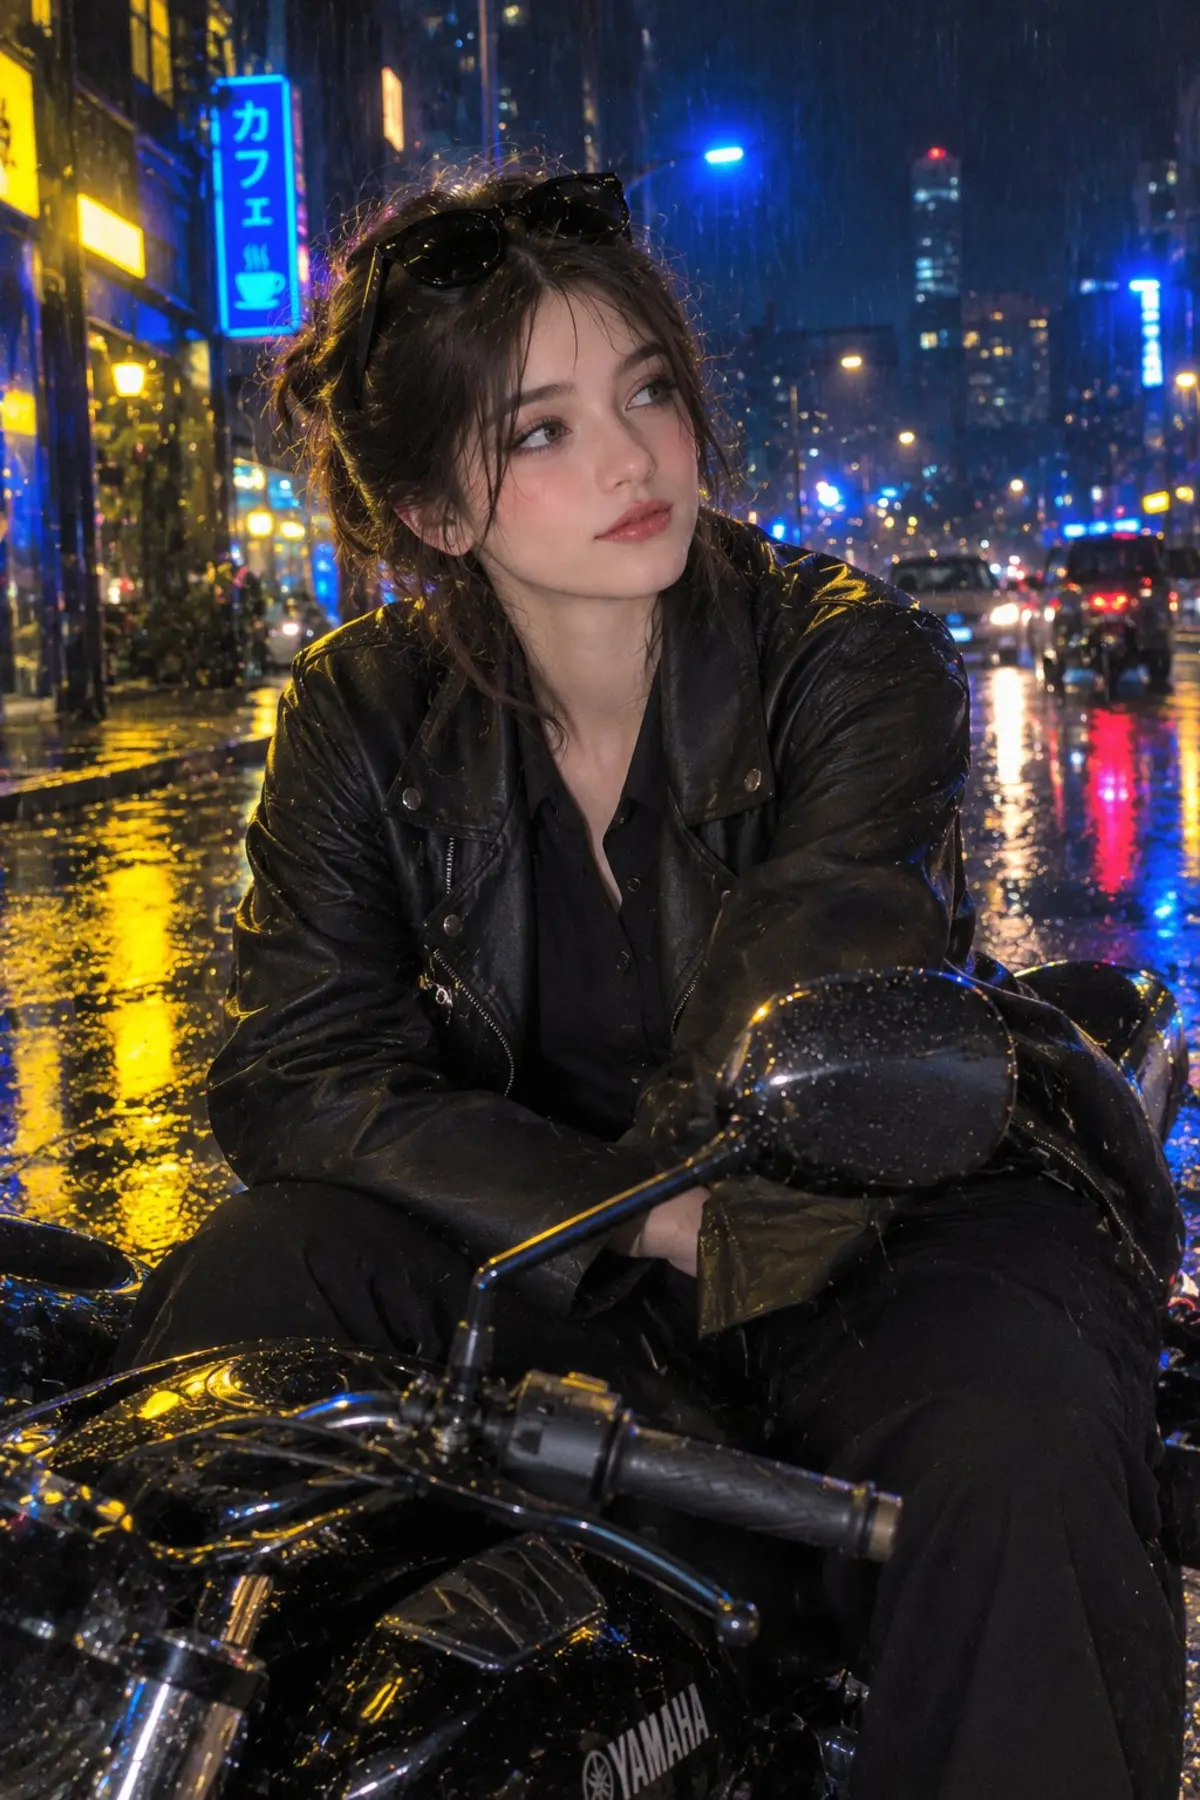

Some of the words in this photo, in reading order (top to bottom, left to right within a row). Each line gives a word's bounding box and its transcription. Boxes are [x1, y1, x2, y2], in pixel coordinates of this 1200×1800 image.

[232, 99, 274, 229] カフェ
[606, 1682, 710, 1800] YAMAHA
